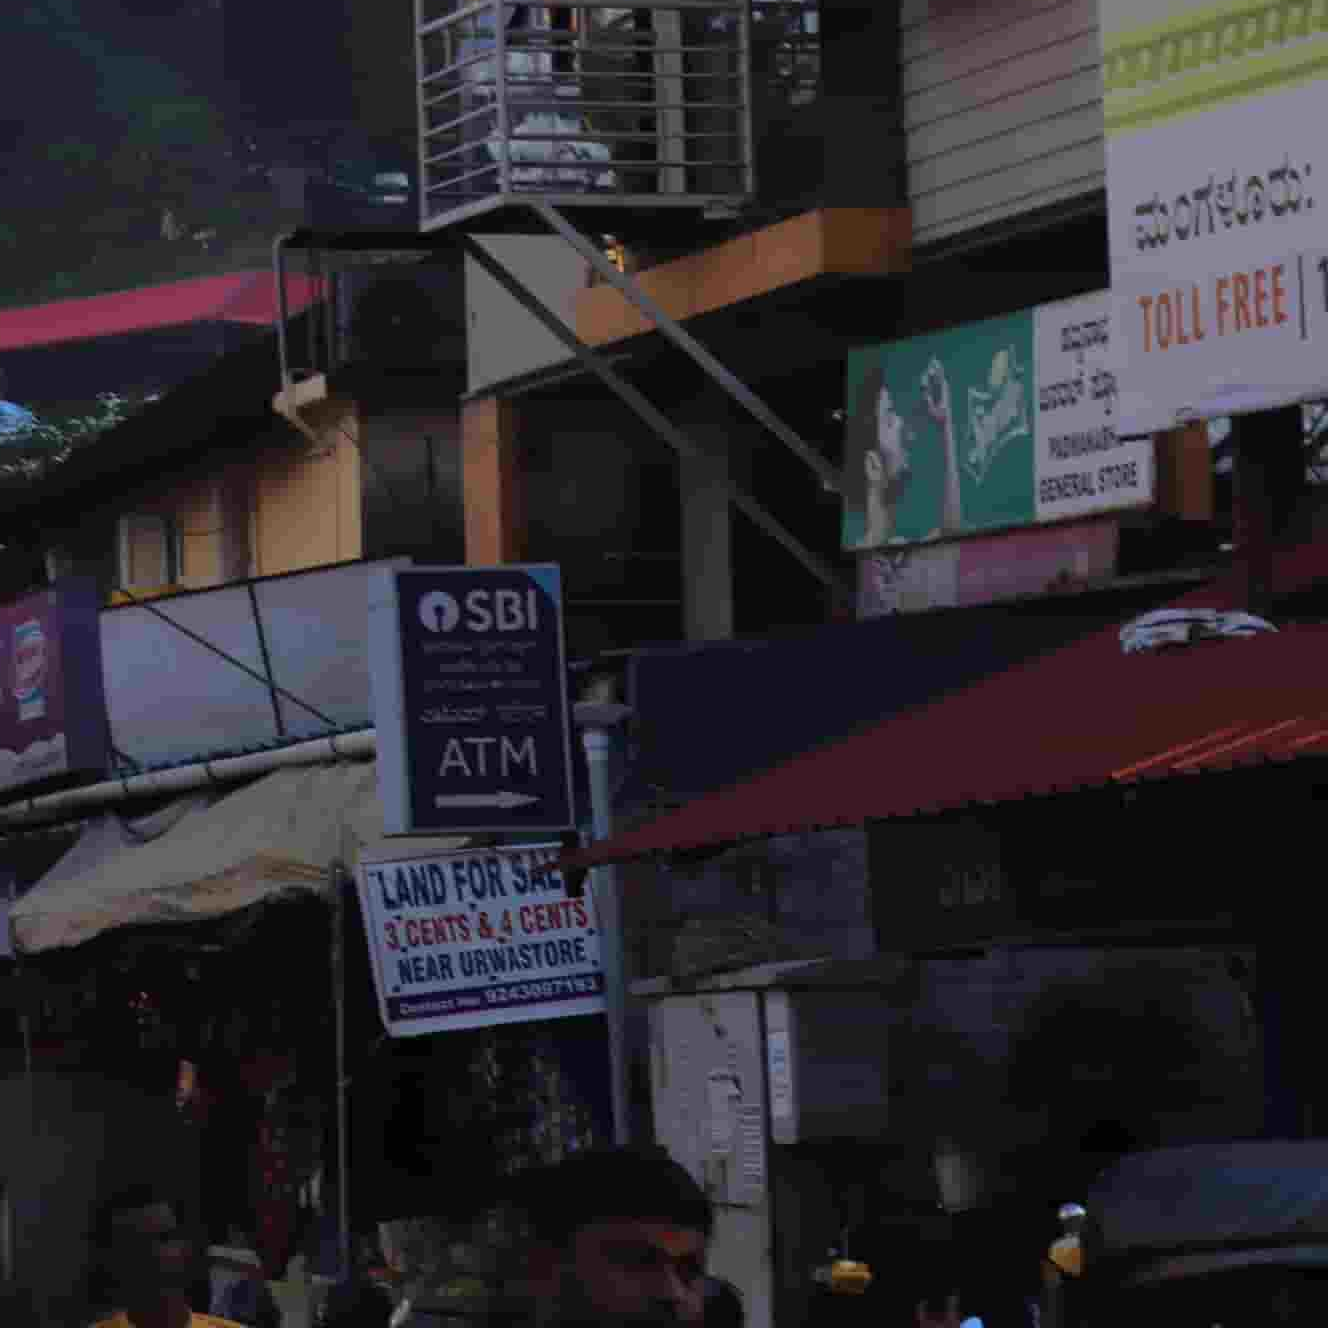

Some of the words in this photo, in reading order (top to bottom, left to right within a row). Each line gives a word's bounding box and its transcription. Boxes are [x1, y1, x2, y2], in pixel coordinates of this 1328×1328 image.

[1136, 284, 1205, 352] TOLL
[1215, 264, 1292, 336] FREE
[1040, 473, 1096, 503] GENERAL
[1098, 461, 1137, 493] STORE
[466, 589, 537, 632] SBI
[439, 736, 537, 777] ATM
[378, 864, 447, 910] LAND
[451, 861, 507, 902] FOR
[510, 859, 564, 895] SAL
[384, 920, 400, 950] 3
[405, 913, 473, 947] CENTS
[520, 897, 589, 935] CENTS
[397, 952, 455, 985] NEAR
[458, 936, 587, 979] URWASTORE
